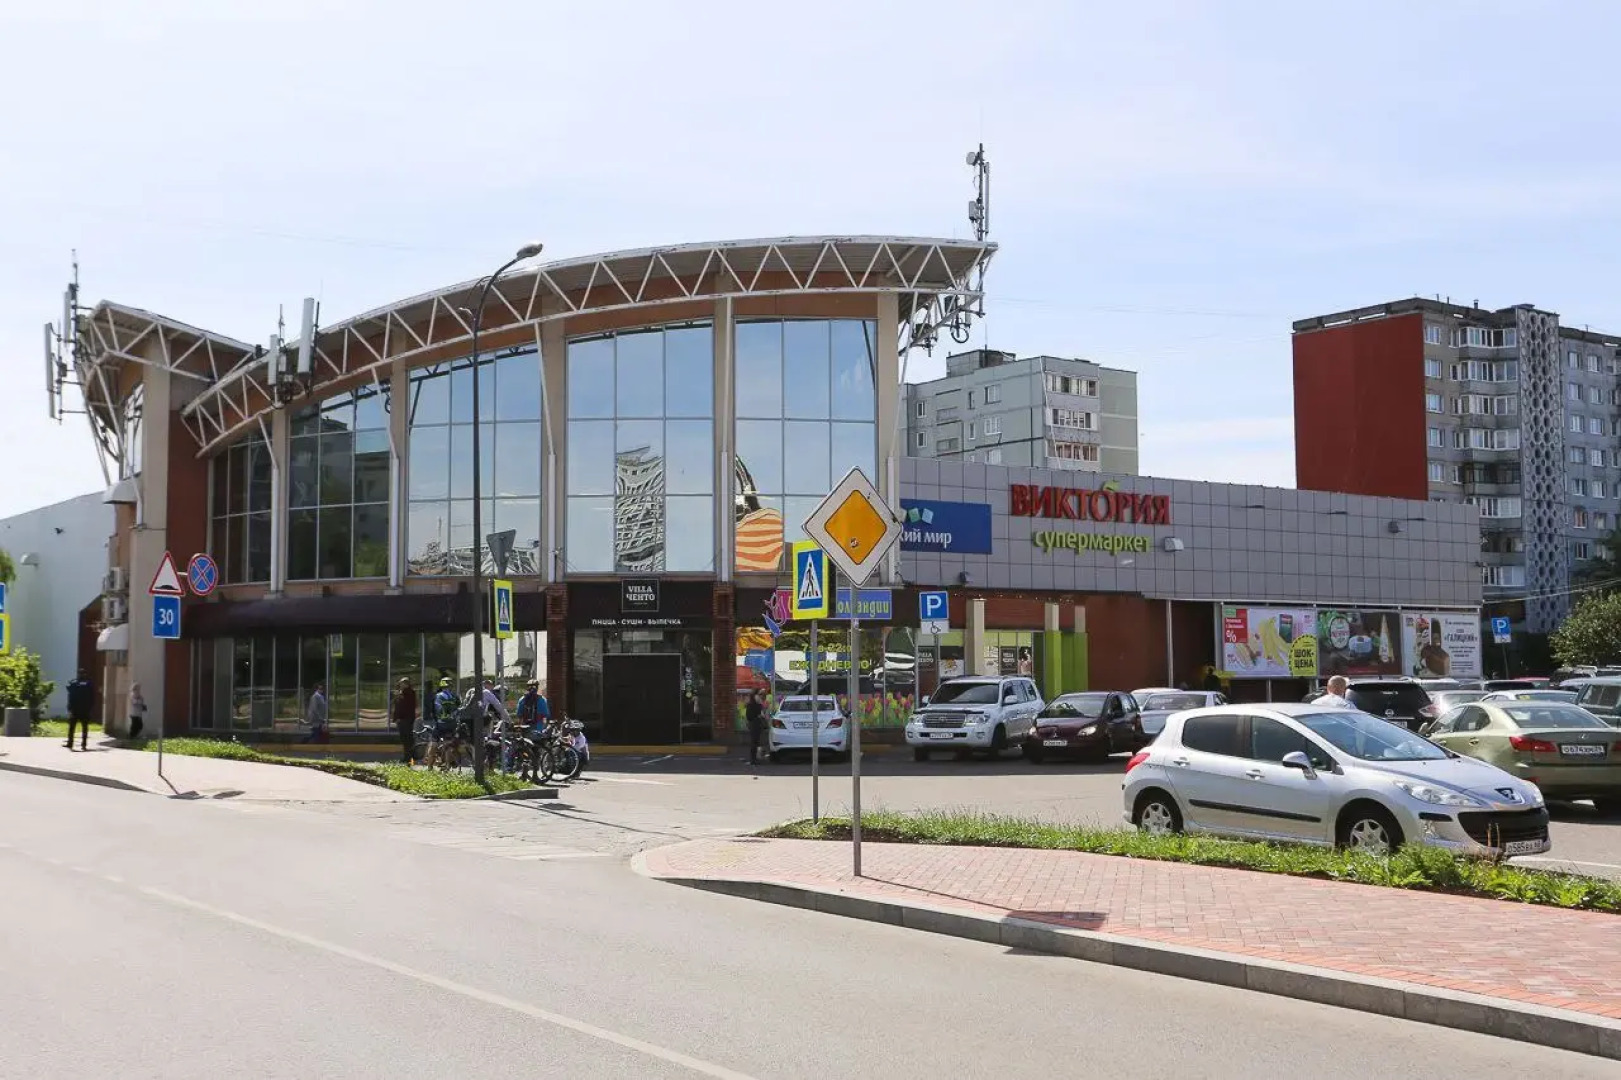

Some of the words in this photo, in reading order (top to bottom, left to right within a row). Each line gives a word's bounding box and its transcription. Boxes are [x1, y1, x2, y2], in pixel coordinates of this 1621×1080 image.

[1010, 484, 1171, 525] ВИКТОРИЯ
[899, 525, 922, 543] кий
[924, 532, 952, 549] мир
[1033, 529, 1151, 556] супермаркет
[626, 593, 655, 601] ЧЕНТО
[628, 585, 653, 593] VILLA
[836, 601, 889, 618] оландии
[926, 595, 942, 616] P
[158, 608, 174, 625] 30
[789, 659, 870, 672] ЕЖДНЕВО
[1294, 659, 1314, 669] ЦЕНА
